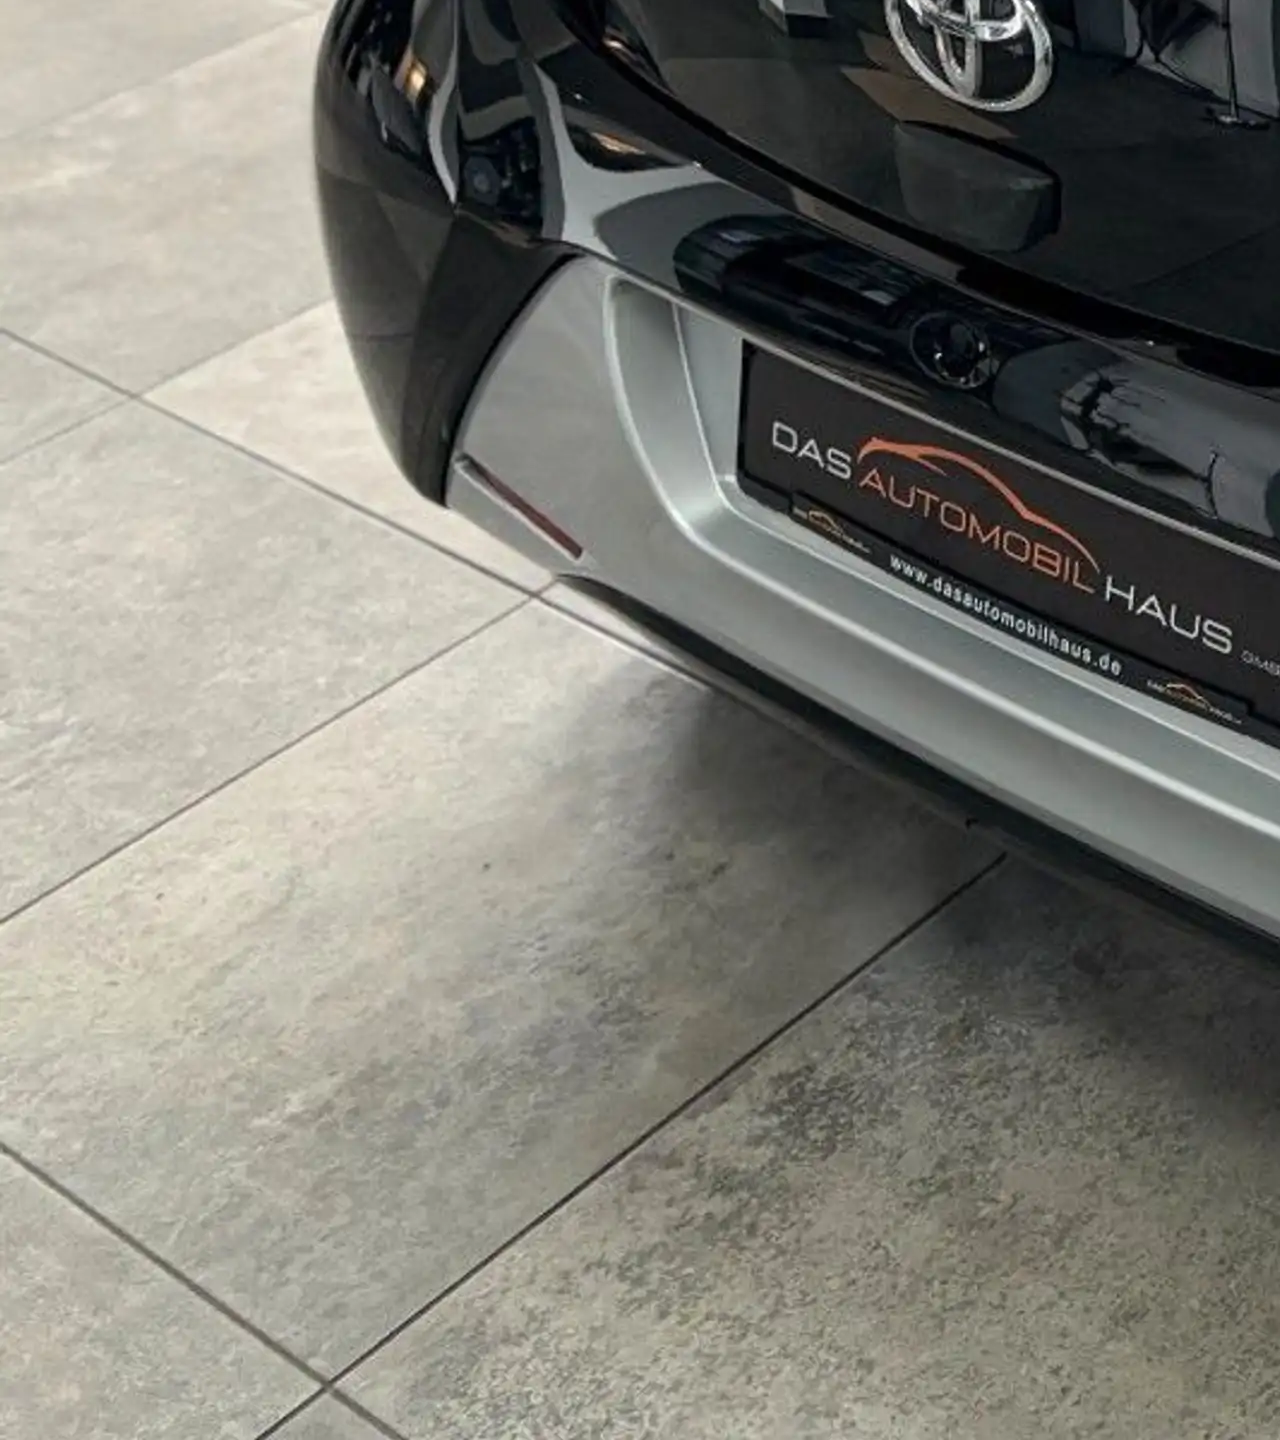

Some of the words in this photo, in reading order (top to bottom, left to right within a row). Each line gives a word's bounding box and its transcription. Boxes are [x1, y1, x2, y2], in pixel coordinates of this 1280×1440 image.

[771, 420, 851, 480] DAS
[858, 467, 1096, 595] AUTOMOBIL
[1105, 574, 1233, 655] HAUS
[888, 553, 1123, 677] www.dasautomobilhaus.de
